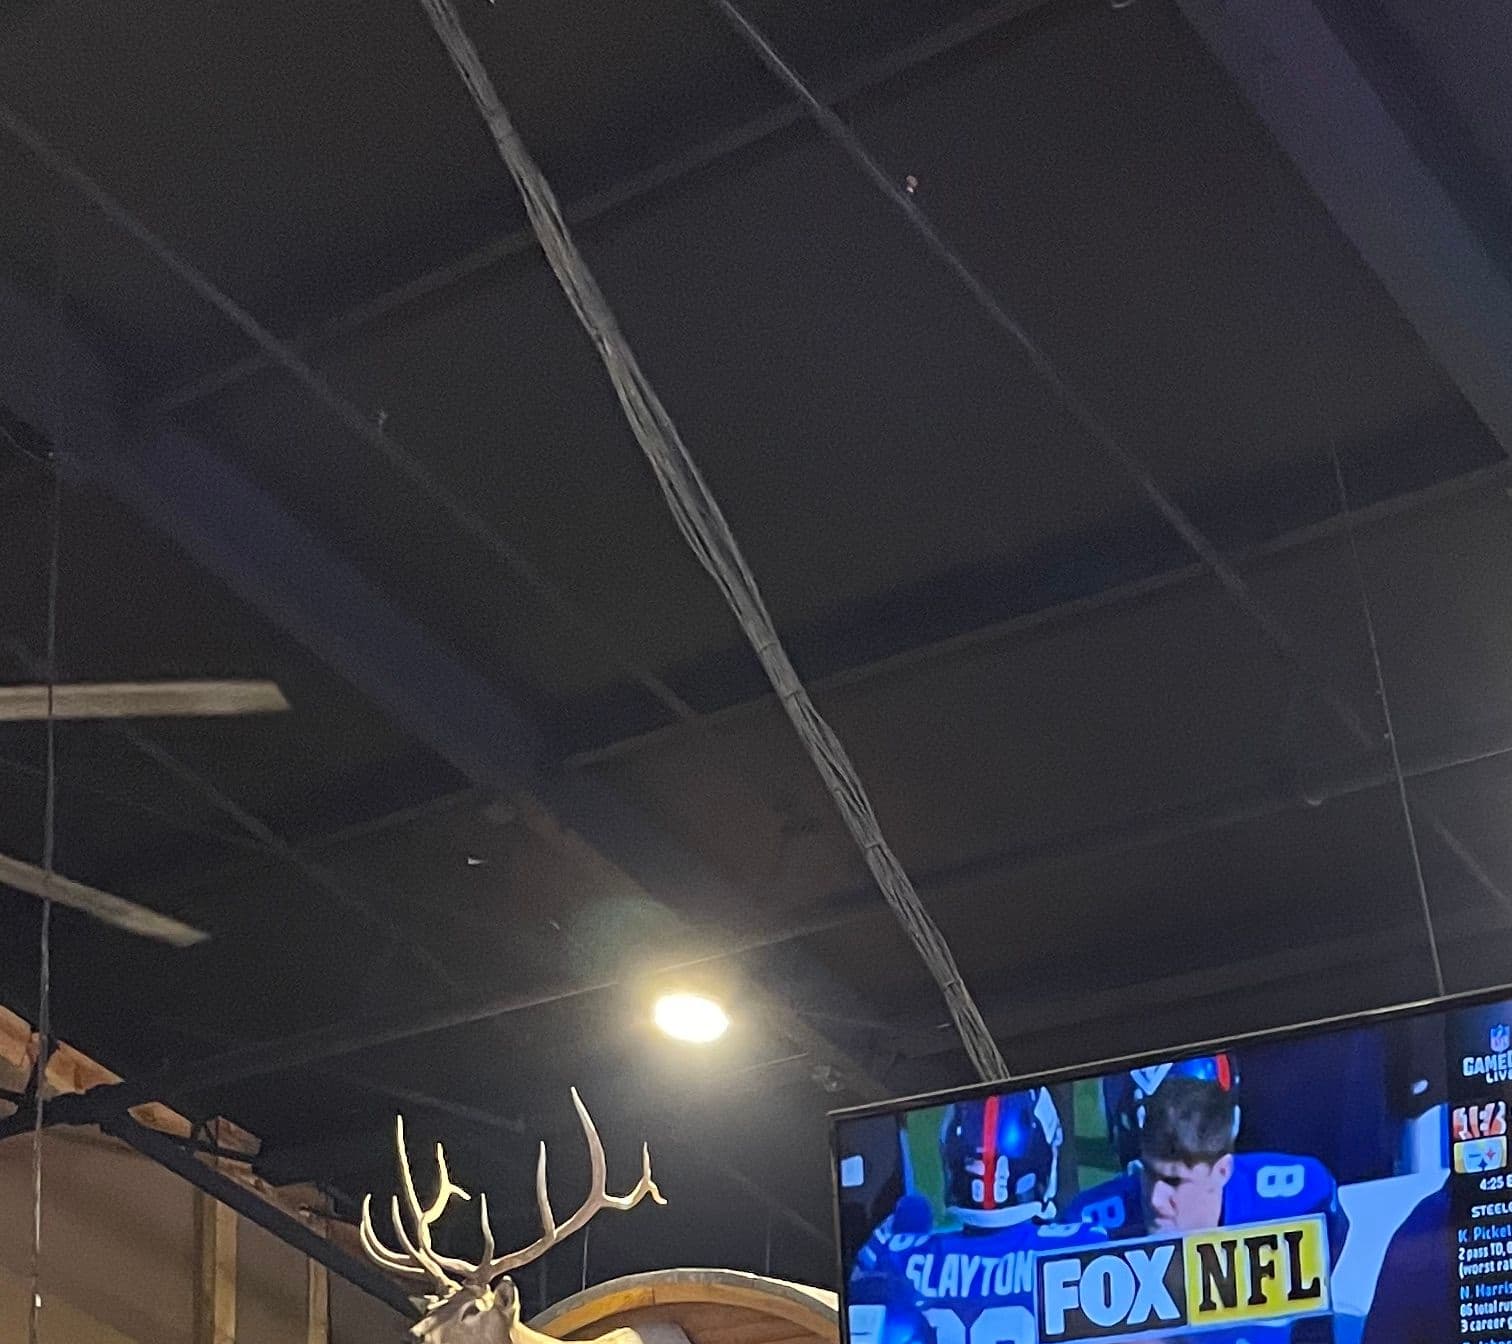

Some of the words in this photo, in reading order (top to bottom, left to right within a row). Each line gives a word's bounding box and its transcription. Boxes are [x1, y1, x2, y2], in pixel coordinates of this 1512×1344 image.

[1480, 1176, 1504, 1190] 4:25
[1196, 1230, 1323, 1311] NFL
[1042, 1244, 1182, 1336] FOX
[1474, 1300, 1497, 1315] total
[1470, 1317, 1505, 1332] career
